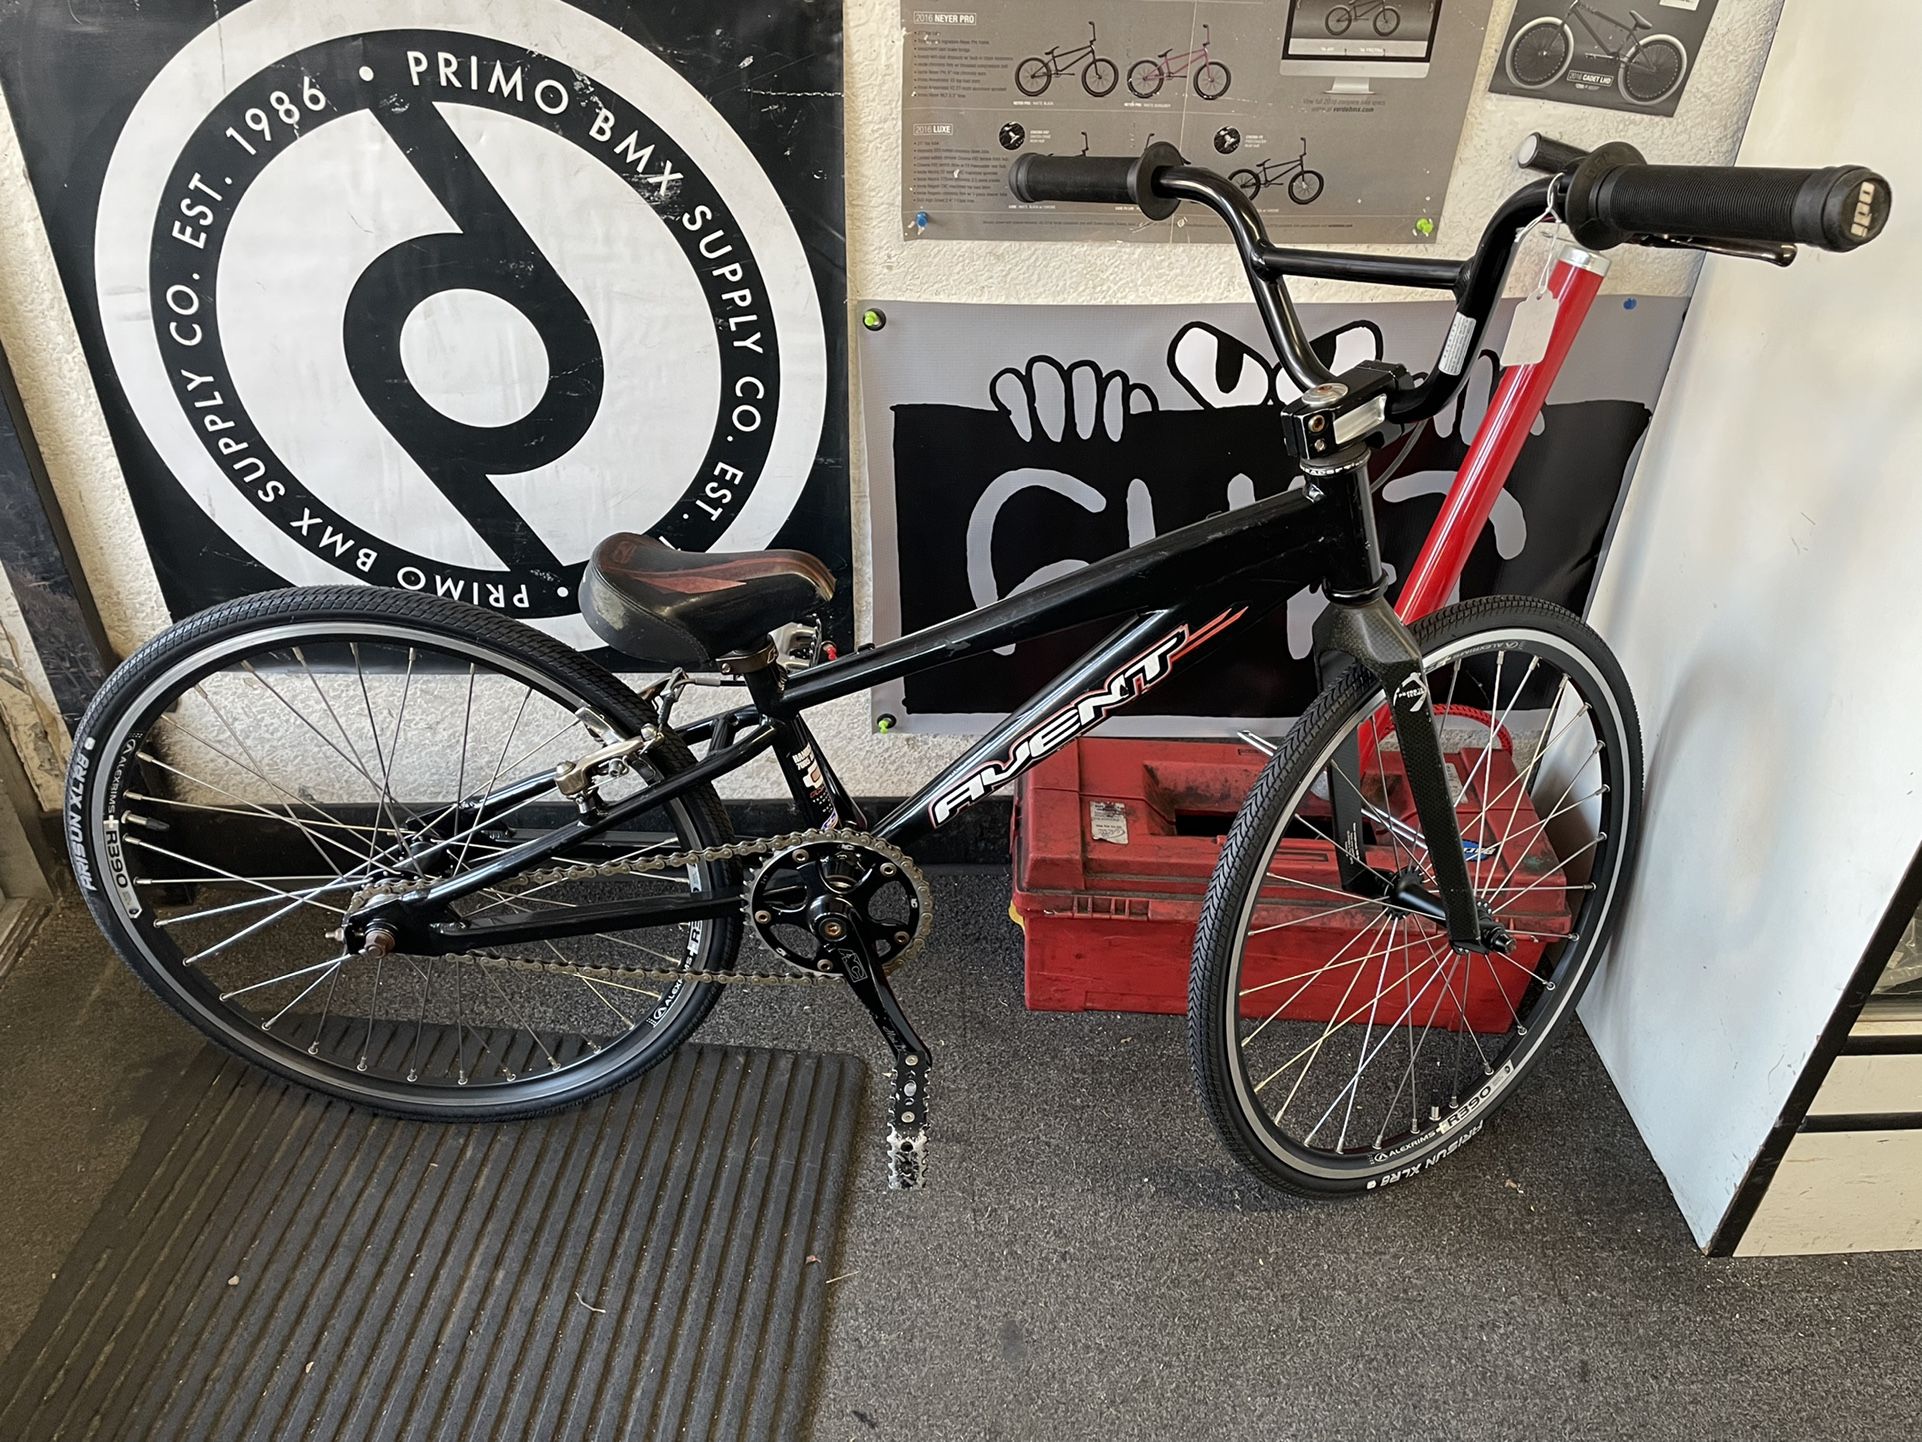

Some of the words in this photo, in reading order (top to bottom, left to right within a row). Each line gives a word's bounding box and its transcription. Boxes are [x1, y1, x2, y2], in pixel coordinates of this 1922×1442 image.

[935, 14, 958, 23] NEYER
[959, 14, 975, 24] PRO
[225, 75, 327, 156] 1986
[933, 125, 951, 133] LUXE
[406, 50, 569, 115] PRIMO
[588, 107, 684, 197] BMX
[682, 205, 764, 354] SUPPLY
[180, 369, 286, 503] SUPPLY
[289, 507, 378, 573] BMX
[396, 566, 530, 608] PRIMO
[932, 630, 1184, 826] AVENT
[107, 756, 128, 815] ALEXRIMS
[68, 814, 98, 891] ARISUN
[105, 829, 128, 889] R390
[1447, 1085, 1492, 1128] R390
[1388, 1130, 1437, 1157] ALEXRIMS
[1424, 1118, 1484, 1169] ARISUN
